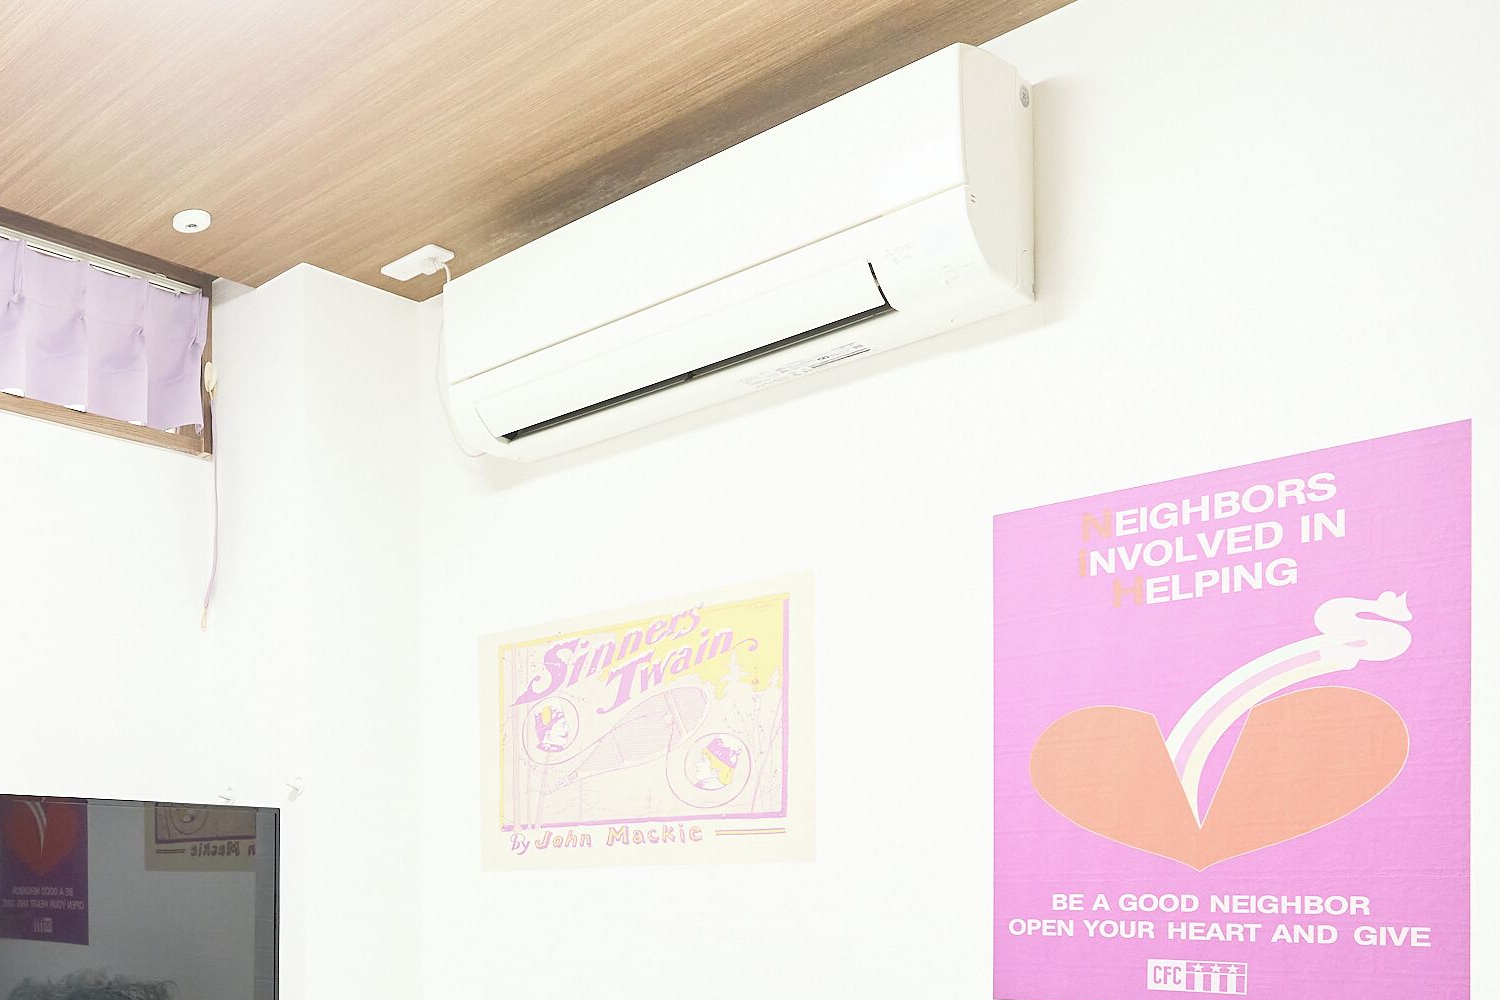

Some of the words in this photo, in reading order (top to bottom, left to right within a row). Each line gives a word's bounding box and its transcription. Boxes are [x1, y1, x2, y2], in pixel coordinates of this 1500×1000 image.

[1081, 472, 1338, 543] NEIGHBORS
[1078, 520, 1285, 578] INVOLVED
[1300, 508, 1347, 545] IN
[1112, 557, 1299, 608] HELPING
[509, 601, 706, 707] Sinners
[595, 628, 758, 714] Twain
[510, 832, 531, 856] By
[535, 830, 593, 849] John
[606, 823, 704, 847] Mackie
[1051, 893, 1084, 911] BE
[1091, 894, 1111, 912] A
[1118, 894, 1199, 913] GOOD
[1210, 894, 1370, 916] NEIGHBOR
[1008, 918, 1074, 937] OPEN
[1083, 919, 1156, 939] YOUR
[1167, 921, 1263, 943] HEART
[1270, 924, 1339, 945] AND
[1353, 925, 1432, 948] GIVE
[1153, 964, 1182, 986] CFC
